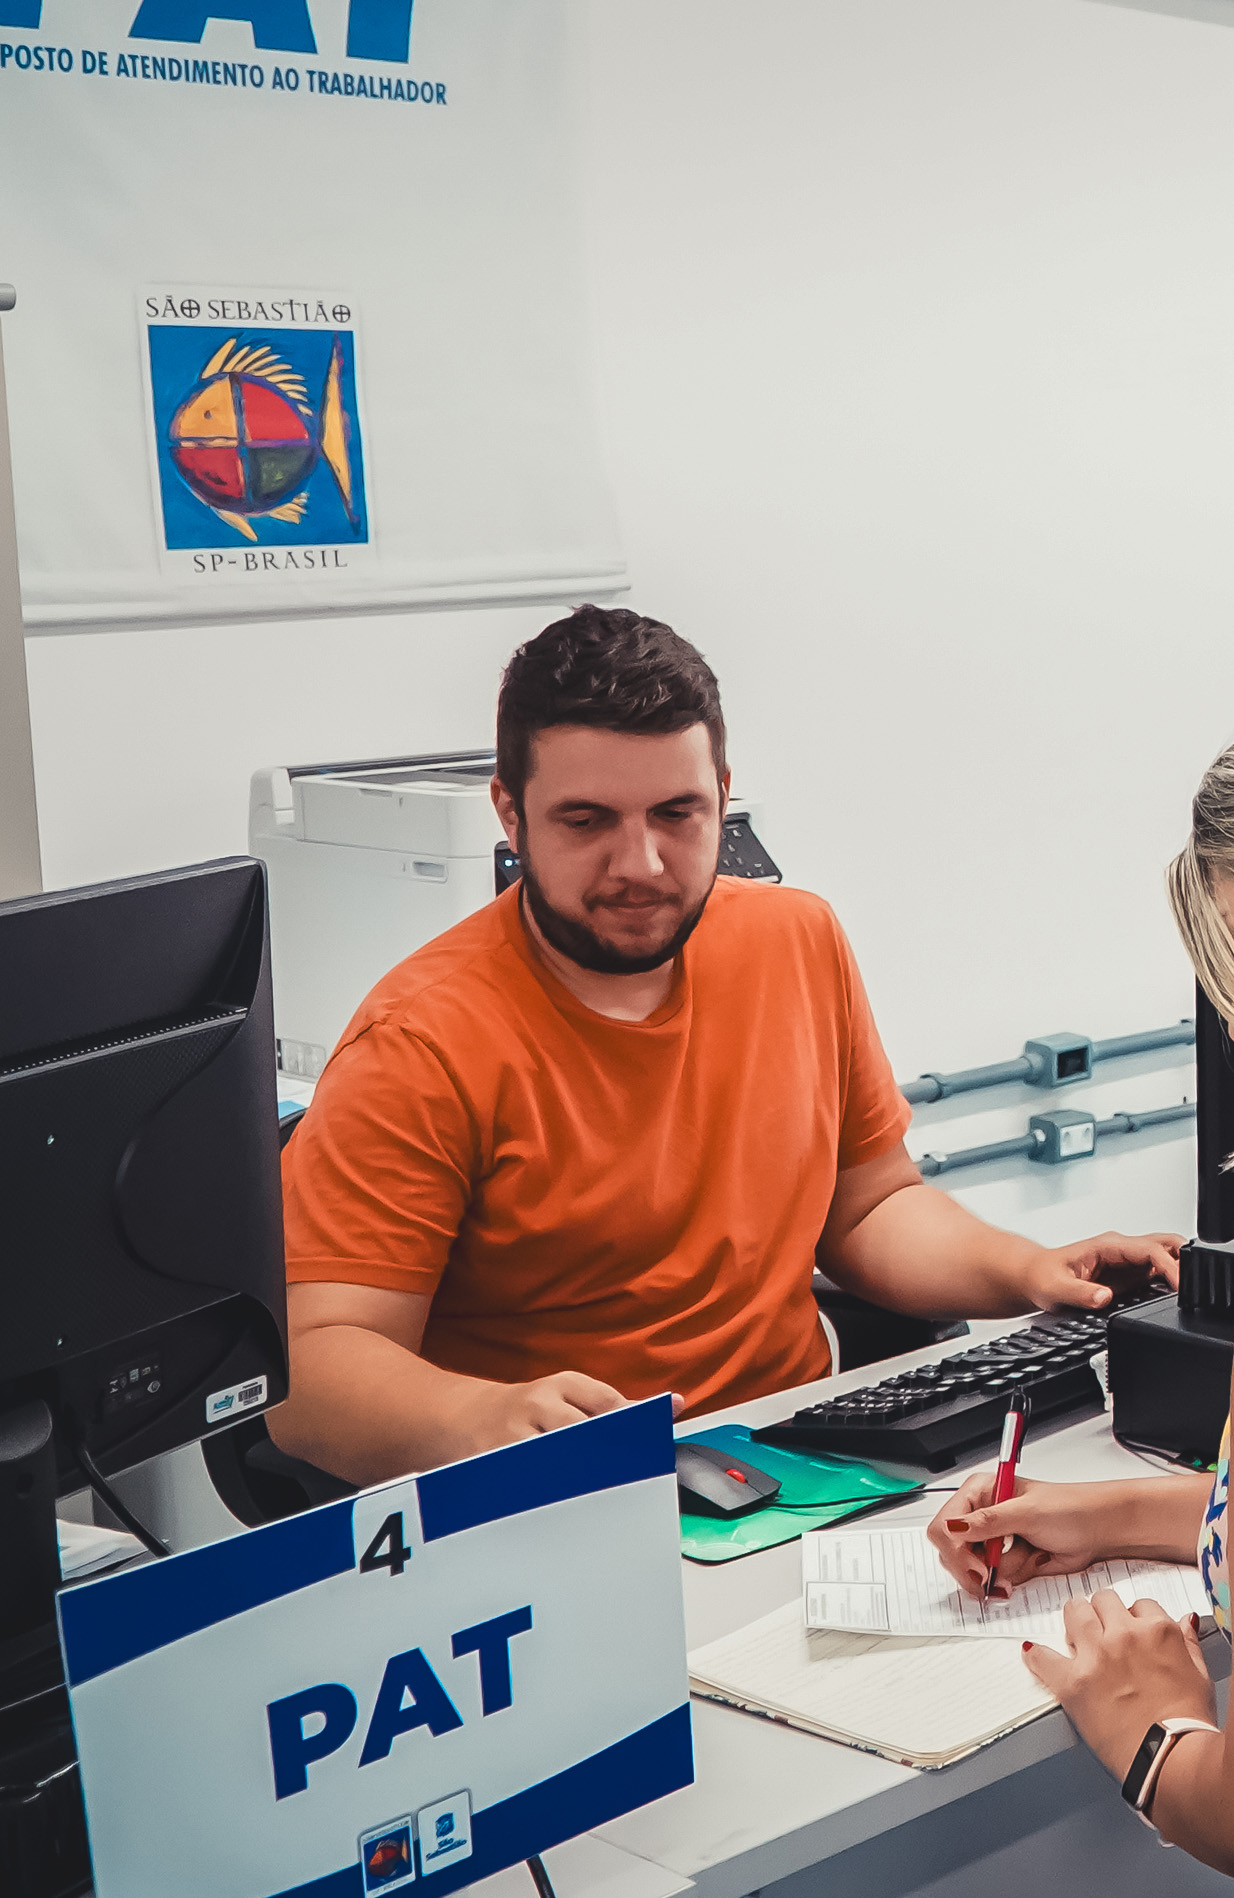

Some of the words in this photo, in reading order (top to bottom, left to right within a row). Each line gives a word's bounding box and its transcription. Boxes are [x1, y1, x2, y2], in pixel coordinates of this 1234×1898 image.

[0, 43, 73, 74] POSTO
[81, 50, 109, 76] DE
[116, 54, 265, 89] ATENDIMENTO
[272, 66, 299, 92] AO
[306, 69, 448, 105] TRABALHADOR
[146, 295, 200, 319] SÃO
[207, 298, 351, 323] SEBASTIÃO
[193, 549, 348, 574] SP-BRASIL
[359, 1510, 412, 1577] 4
[266, 1604, 532, 1802] PAT
